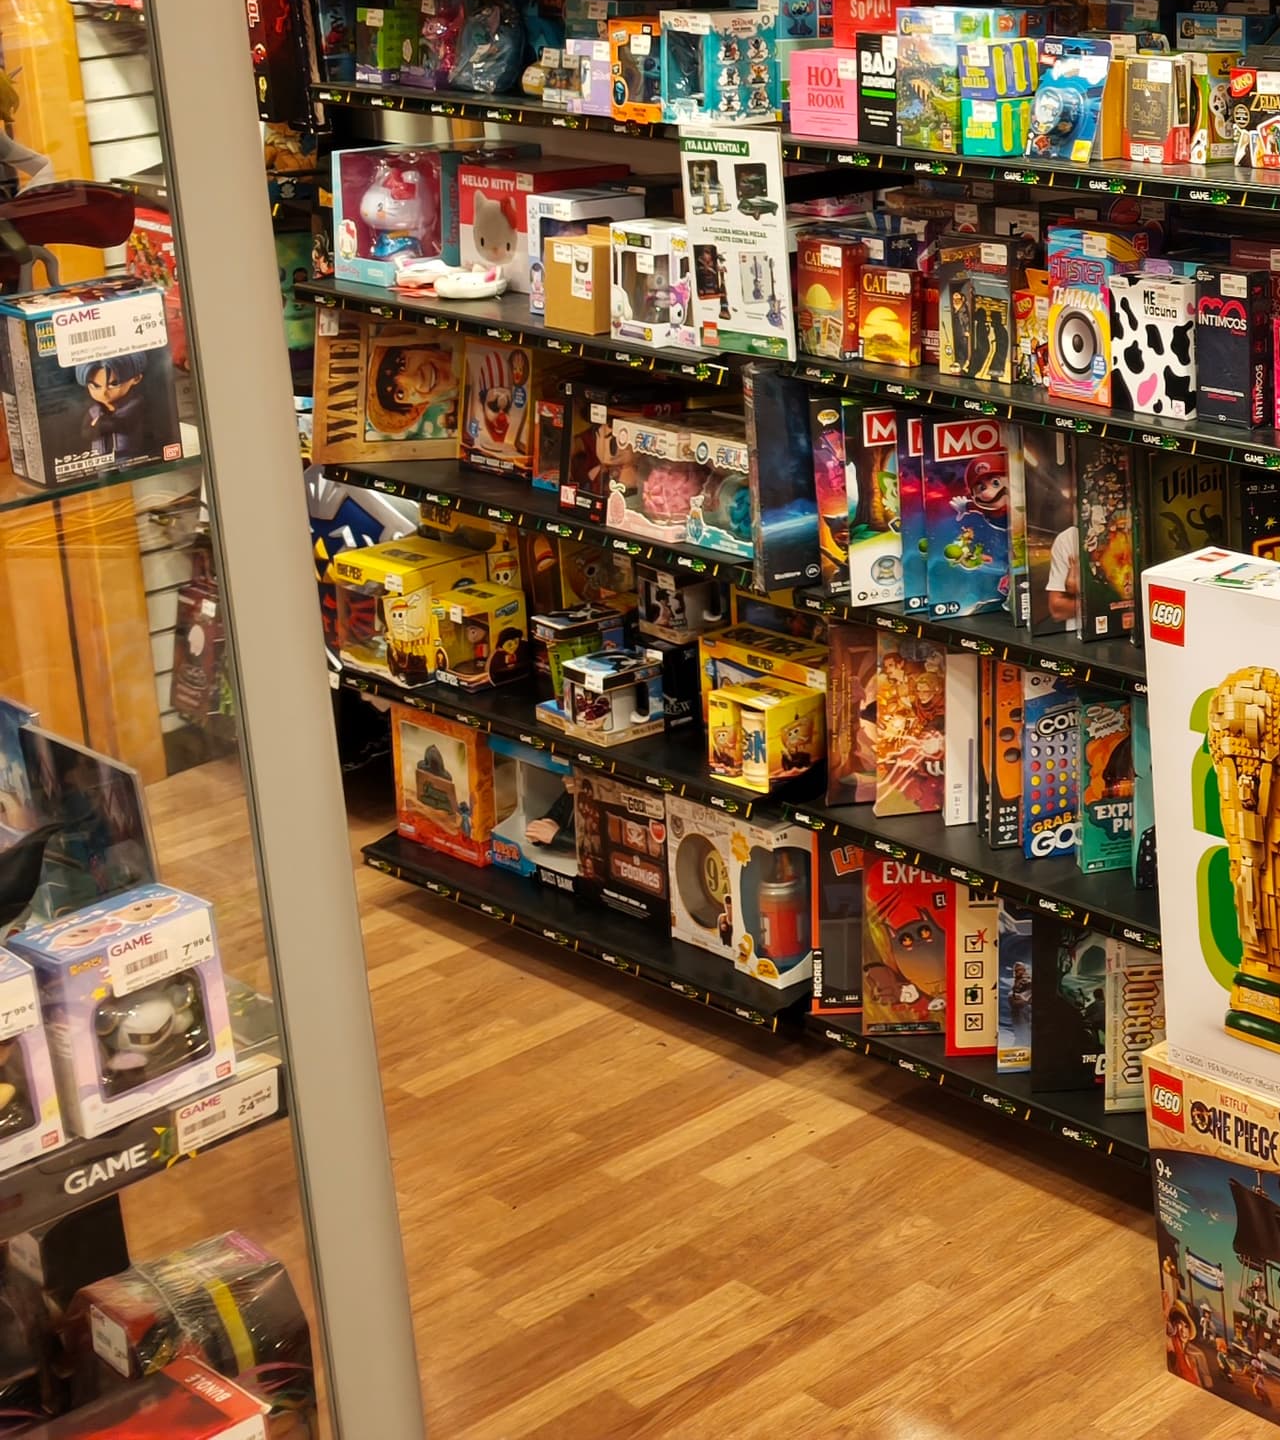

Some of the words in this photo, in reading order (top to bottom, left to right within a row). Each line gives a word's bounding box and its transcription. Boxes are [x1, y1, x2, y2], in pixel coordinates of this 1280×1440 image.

[861, 50, 896, 75] BAD
[808, 66, 842, 88] HOT
[808, 94, 844, 108] ROOM
[1052, 286, 1104, 311] TEMAZOS
[56, 309, 100, 326] GAME
[1144, 304, 1177, 320] vacuna
[110, 932, 153, 957] GAME
[1152, 1086, 1182, 1115] LEGO
[1220, 1094, 1248, 1113] NETFLIX
[64, 1145, 148, 1195] GAME
